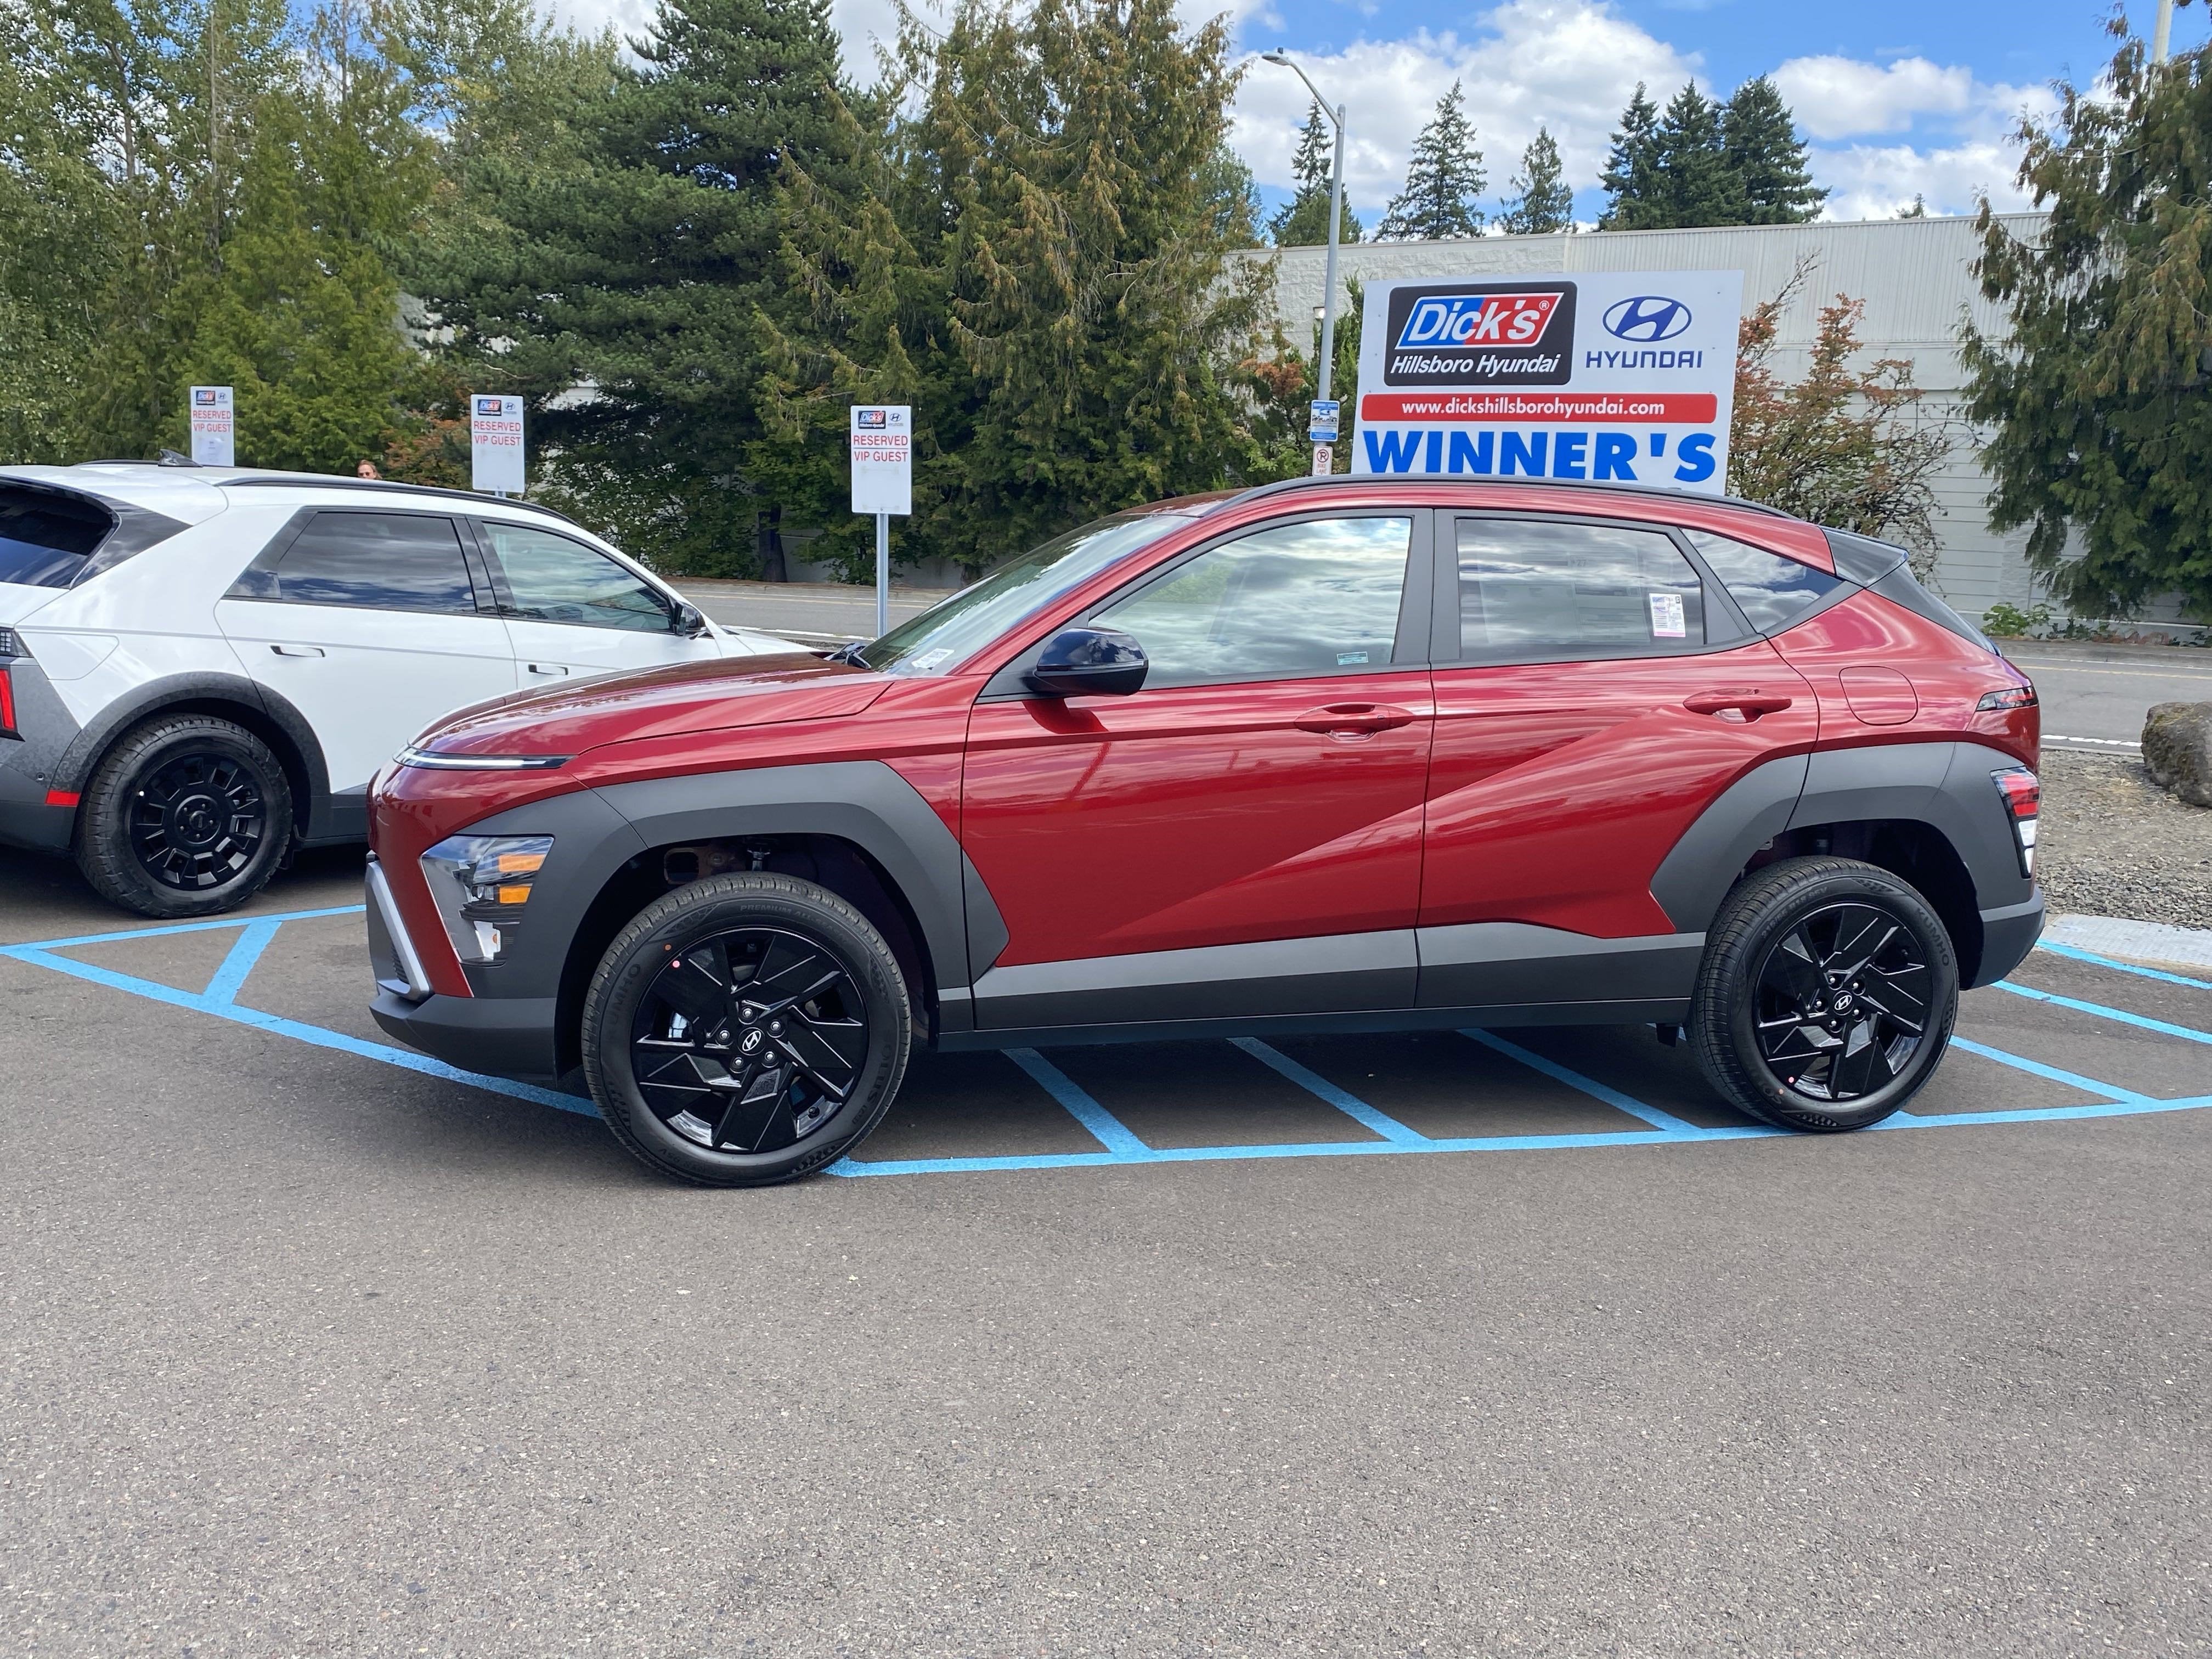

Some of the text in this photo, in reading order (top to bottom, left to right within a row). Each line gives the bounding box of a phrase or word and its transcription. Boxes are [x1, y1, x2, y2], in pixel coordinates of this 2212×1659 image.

[1585, 350, 1703, 368] HYUNDAI
[1390, 354, 1562, 377] Hillsboro Hyundai
[1402, 397, 1665, 419] www.dickshillsborohyundai.com
[193, 410, 232, 419] RESERVED
[193, 423, 232, 432] VIP GUEST
[473, 421, 521, 431] RESERVED
[474, 435, 521, 446] VIP GUEST
[853, 435, 908, 445] RESERVED
[854, 451, 908, 462] VIP GUEST
[1362, 430, 1717, 482] WINNER'S
[1915, 907, 1950, 966] KUMHO
